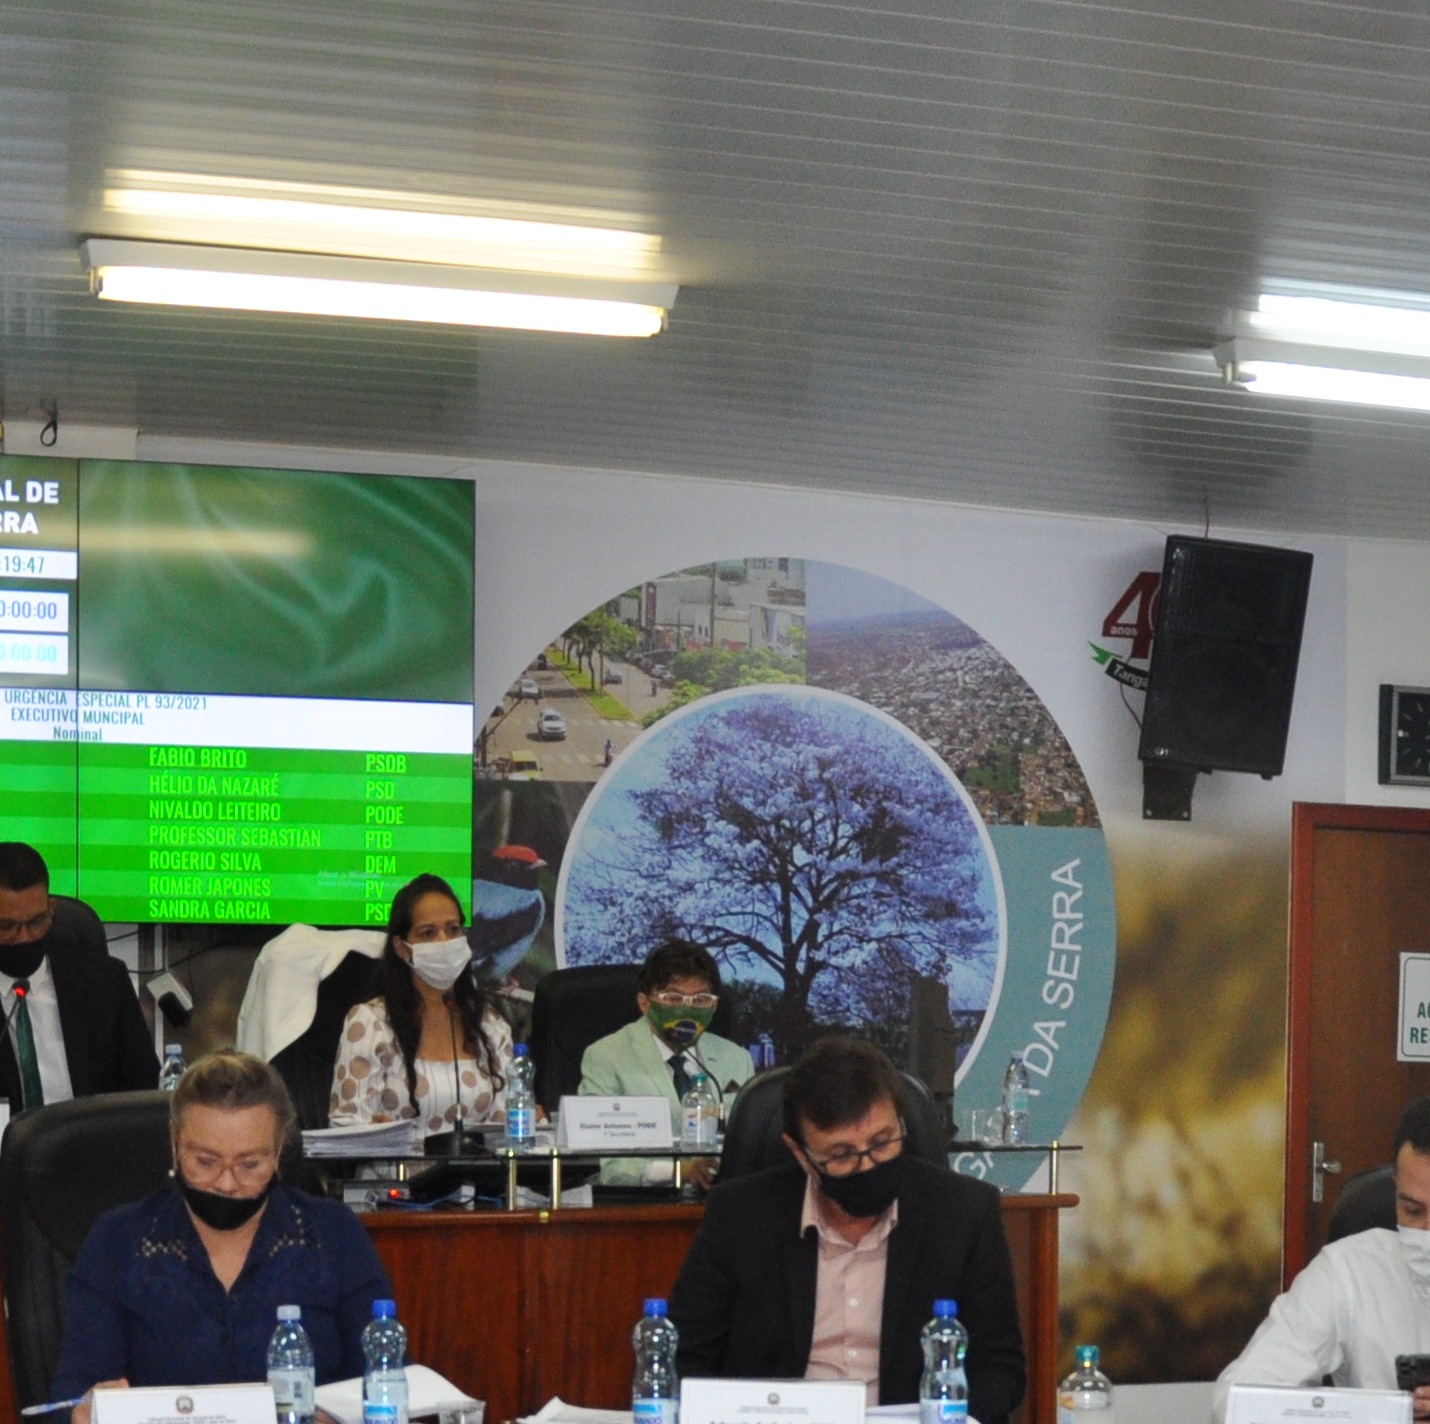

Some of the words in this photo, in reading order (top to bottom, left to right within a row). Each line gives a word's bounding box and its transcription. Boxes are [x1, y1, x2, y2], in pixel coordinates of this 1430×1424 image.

[25, 481, 59, 504] DE
[1110, 626, 1138, 636] anos
[77, 690, 133, 709] ESPECIAL
[137, 694, 150, 709] PL
[155, 694, 208, 711] 93/2021
[11, 707, 78, 723] EXECUTIVO
[83, 710, 145, 726] MUNCIPAL
[53, 725, 103, 741] Nominal
[149, 746, 195, 767] FABIO
[200, 748, 247, 768] BRITO
[366, 753, 407, 773] PSDB
[149, 769, 193, 795] HÉLIO
[197, 774, 217, 795] DA
[221, 772, 279, 797] NAZARÉ
[366, 780, 395, 800] PSD
[149, 800, 213, 821] NIVALDO
[217, 801, 281, 821] LEITEIRO
[366, 805, 404, 825] PODE
[149, 825, 236, 846] PROFESSOR
[241, 826, 321, 848] SEBASTIAN
[366, 830, 393, 849] PTB
[149, 850, 216, 870] ROGERIO
[220, 851, 262, 872] SILVA
[366, 855, 396, 875] DEM
[149, 875, 203, 896] ROMER
[207, 876, 271, 897] JAPONES
[366, 880, 385, 898] PV
[149, 899, 210, 919] SANDRA
[214, 899, 270, 920] GARCIA
[366, 902, 392, 921] PSD
[1042, 858, 1084, 1009] SERRA
[1022, 1020, 1067, 1077] DA
